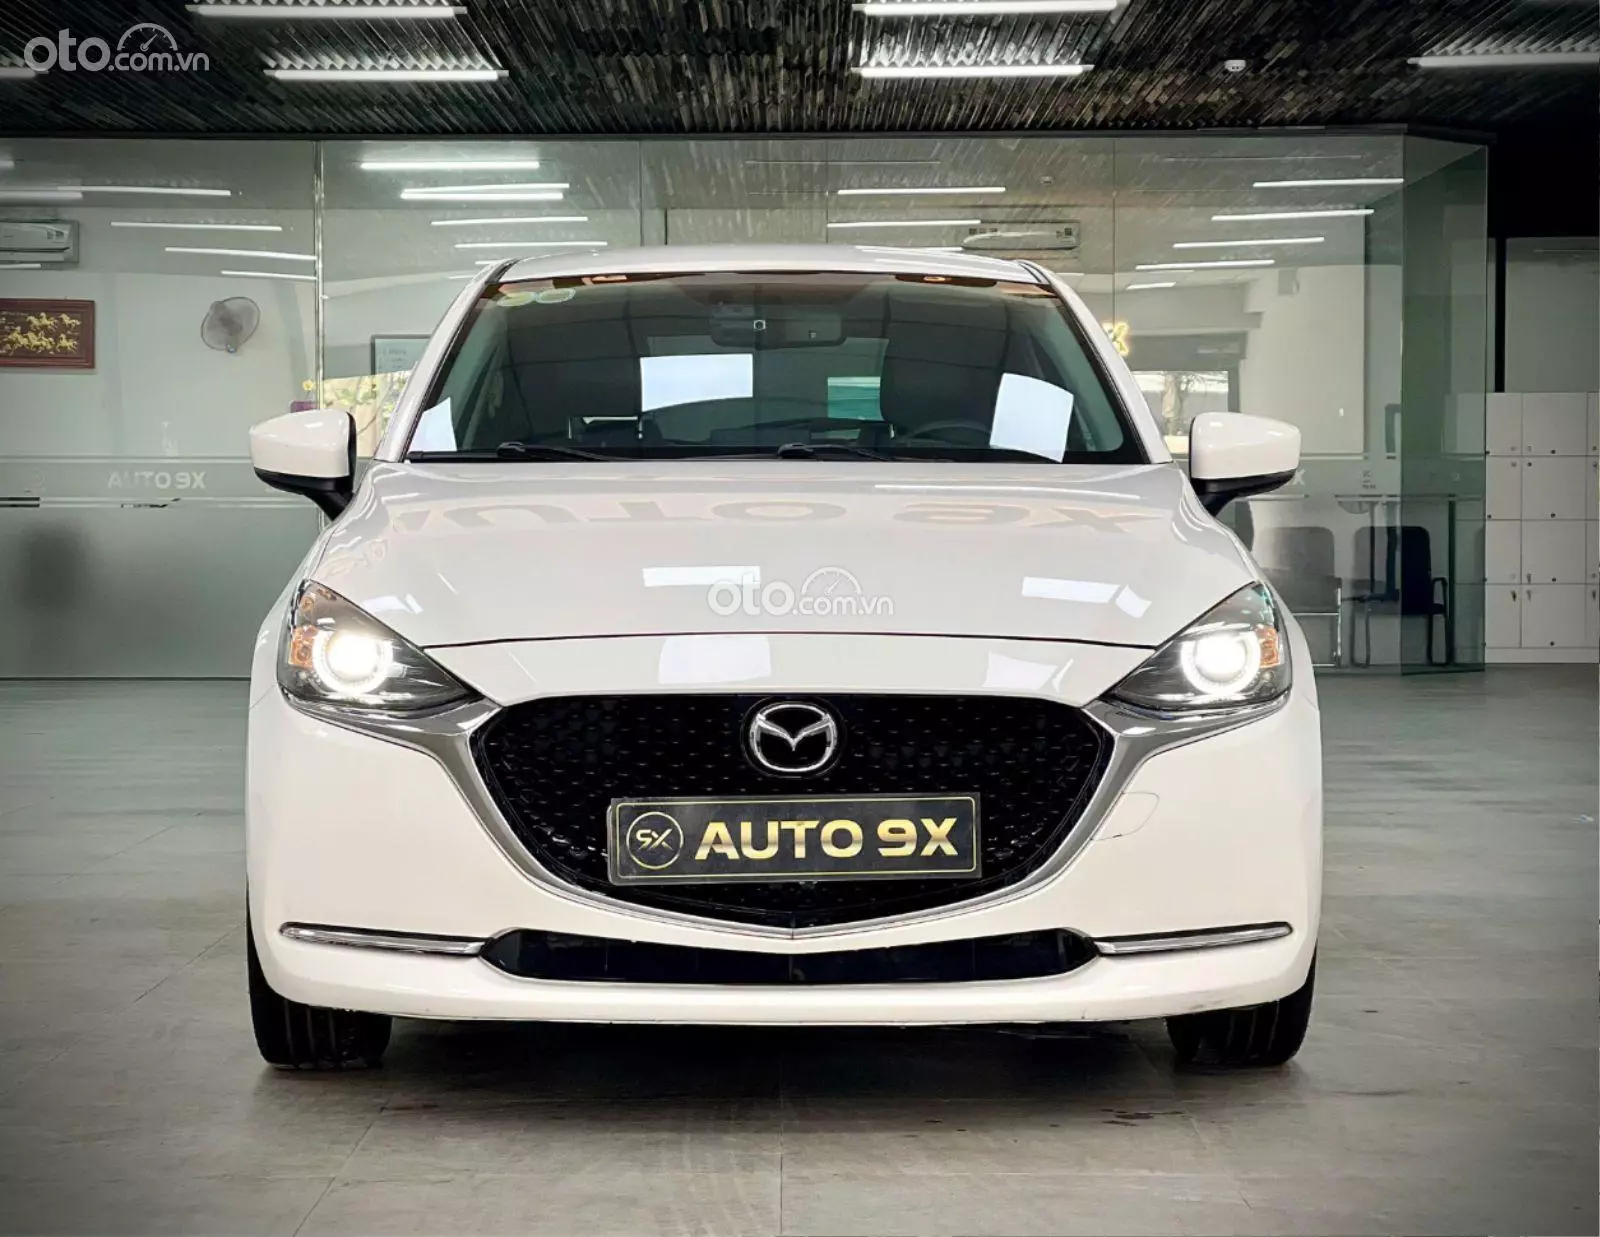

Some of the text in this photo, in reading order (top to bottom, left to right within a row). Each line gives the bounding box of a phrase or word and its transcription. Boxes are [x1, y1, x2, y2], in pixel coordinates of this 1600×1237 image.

[107, 471, 206, 489] AUTO 9X
[694, 817, 958, 860] AUTO 9X
